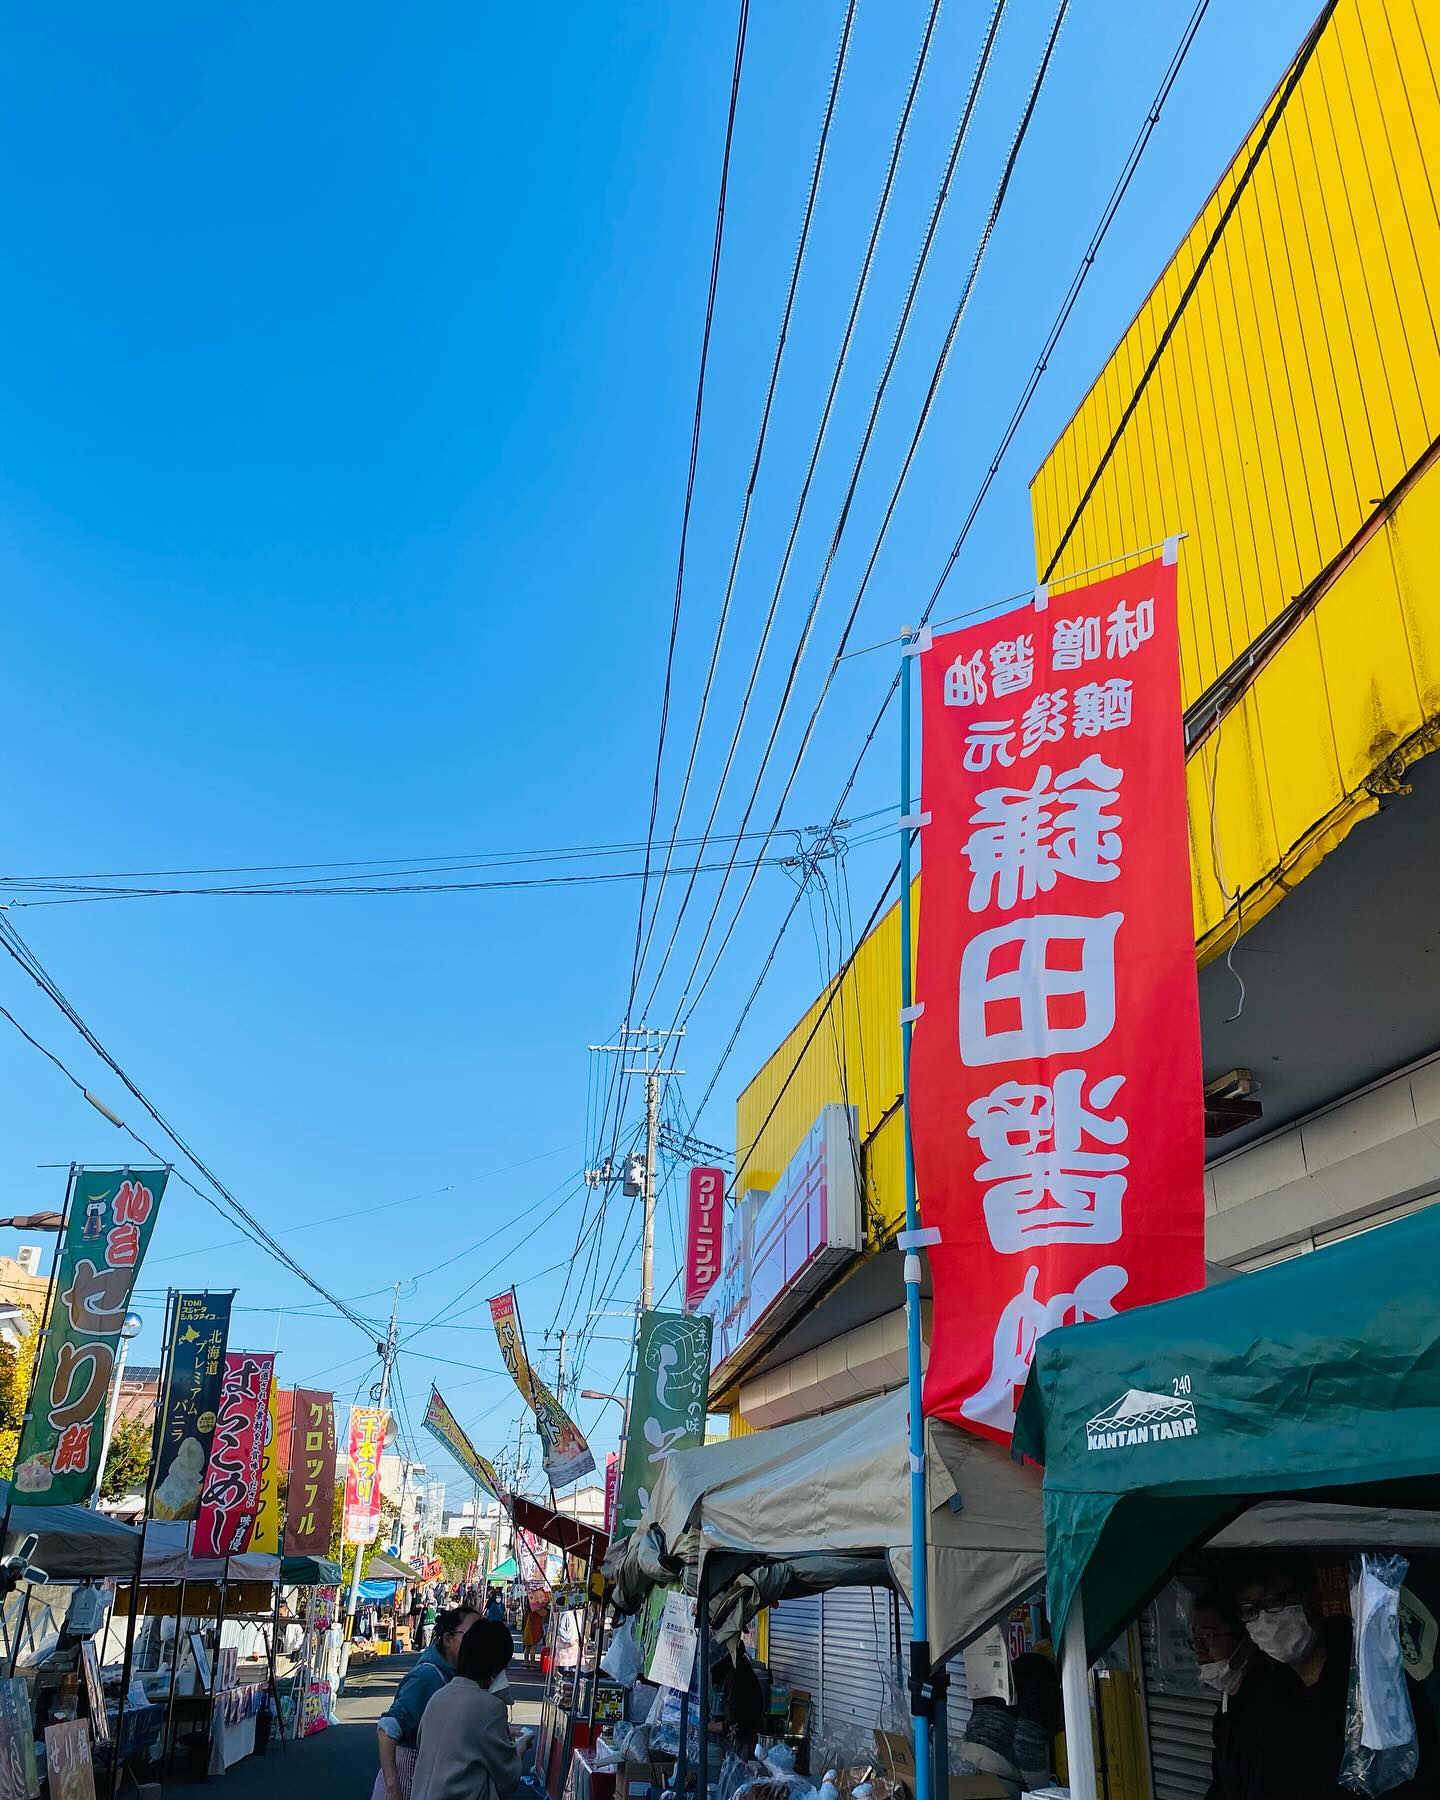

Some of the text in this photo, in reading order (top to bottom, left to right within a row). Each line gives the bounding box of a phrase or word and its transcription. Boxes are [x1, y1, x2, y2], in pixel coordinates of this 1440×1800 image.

[695, 1175, 717, 1285] クリーニング
[205, 1328, 223, 1376] 北海道
[187, 1340, 208, 1416] プレミアム
[1172, 1374, 1192, 1397] 240
[171, 1400, 189, 1442] バニラ
[1087, 1426, 1149, 1450] KANTAN
[228, 1513, 253, 1551] 味自慢
